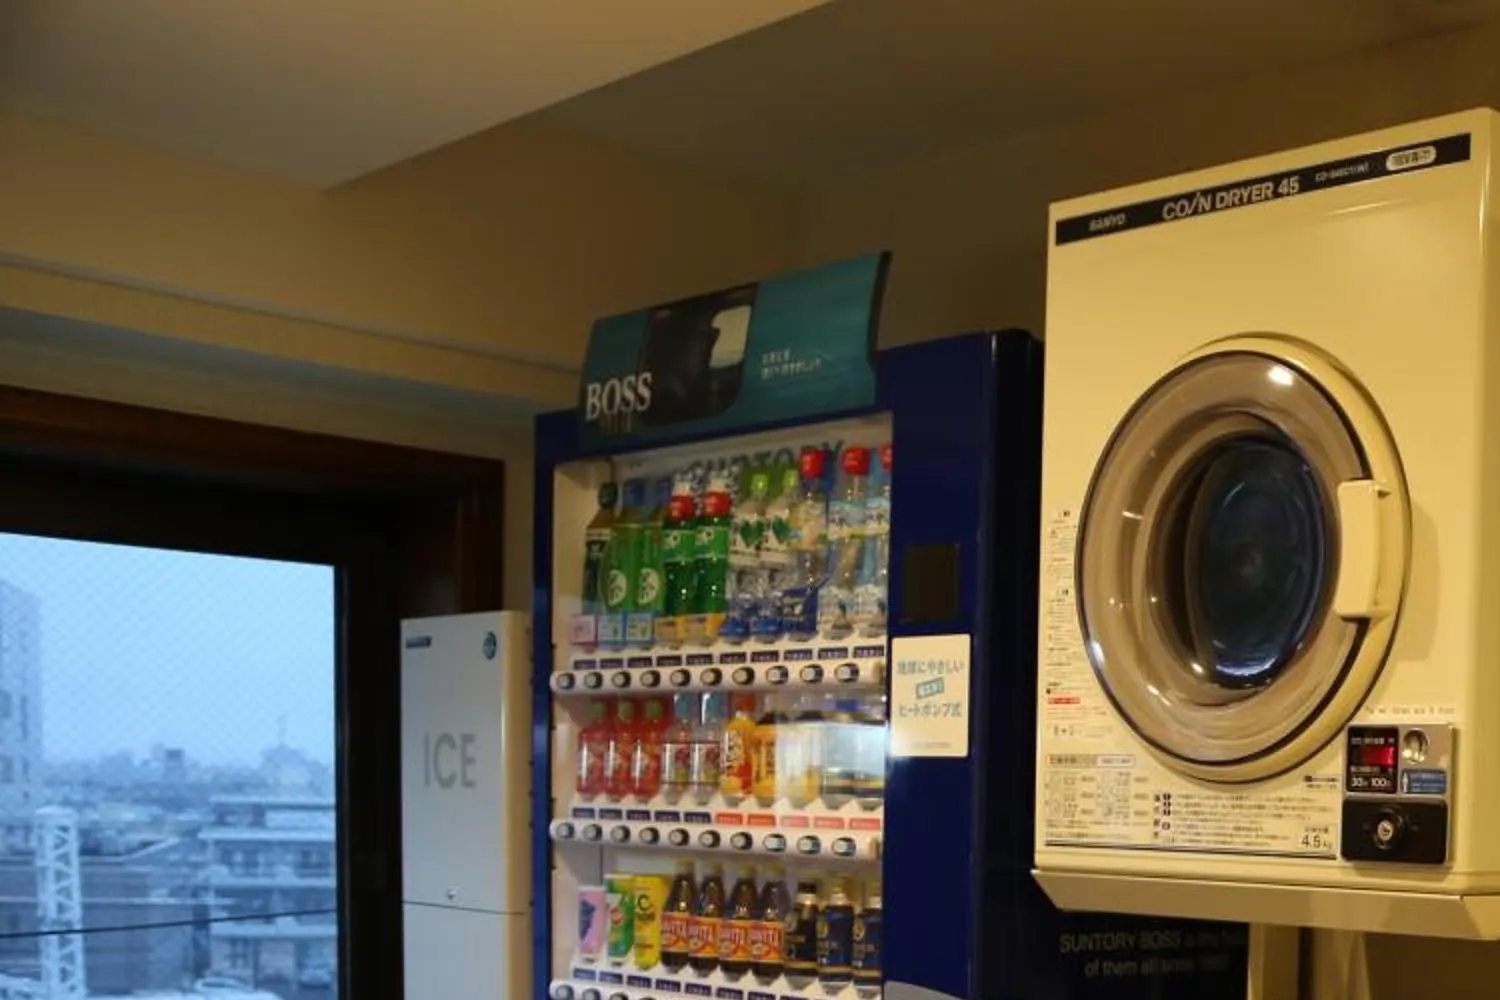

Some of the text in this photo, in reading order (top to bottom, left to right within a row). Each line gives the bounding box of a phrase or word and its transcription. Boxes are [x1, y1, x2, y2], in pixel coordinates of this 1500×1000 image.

[1215, 181, 1274, 209] DRYER
[1277, 176, 1300, 195] 45
[586, 371, 653, 421] BOSS
[424, 733, 477, 788] ICE
[1060, 931, 1135, 953] SUNTORY
[1139, 929, 1182, 948] BOSS
